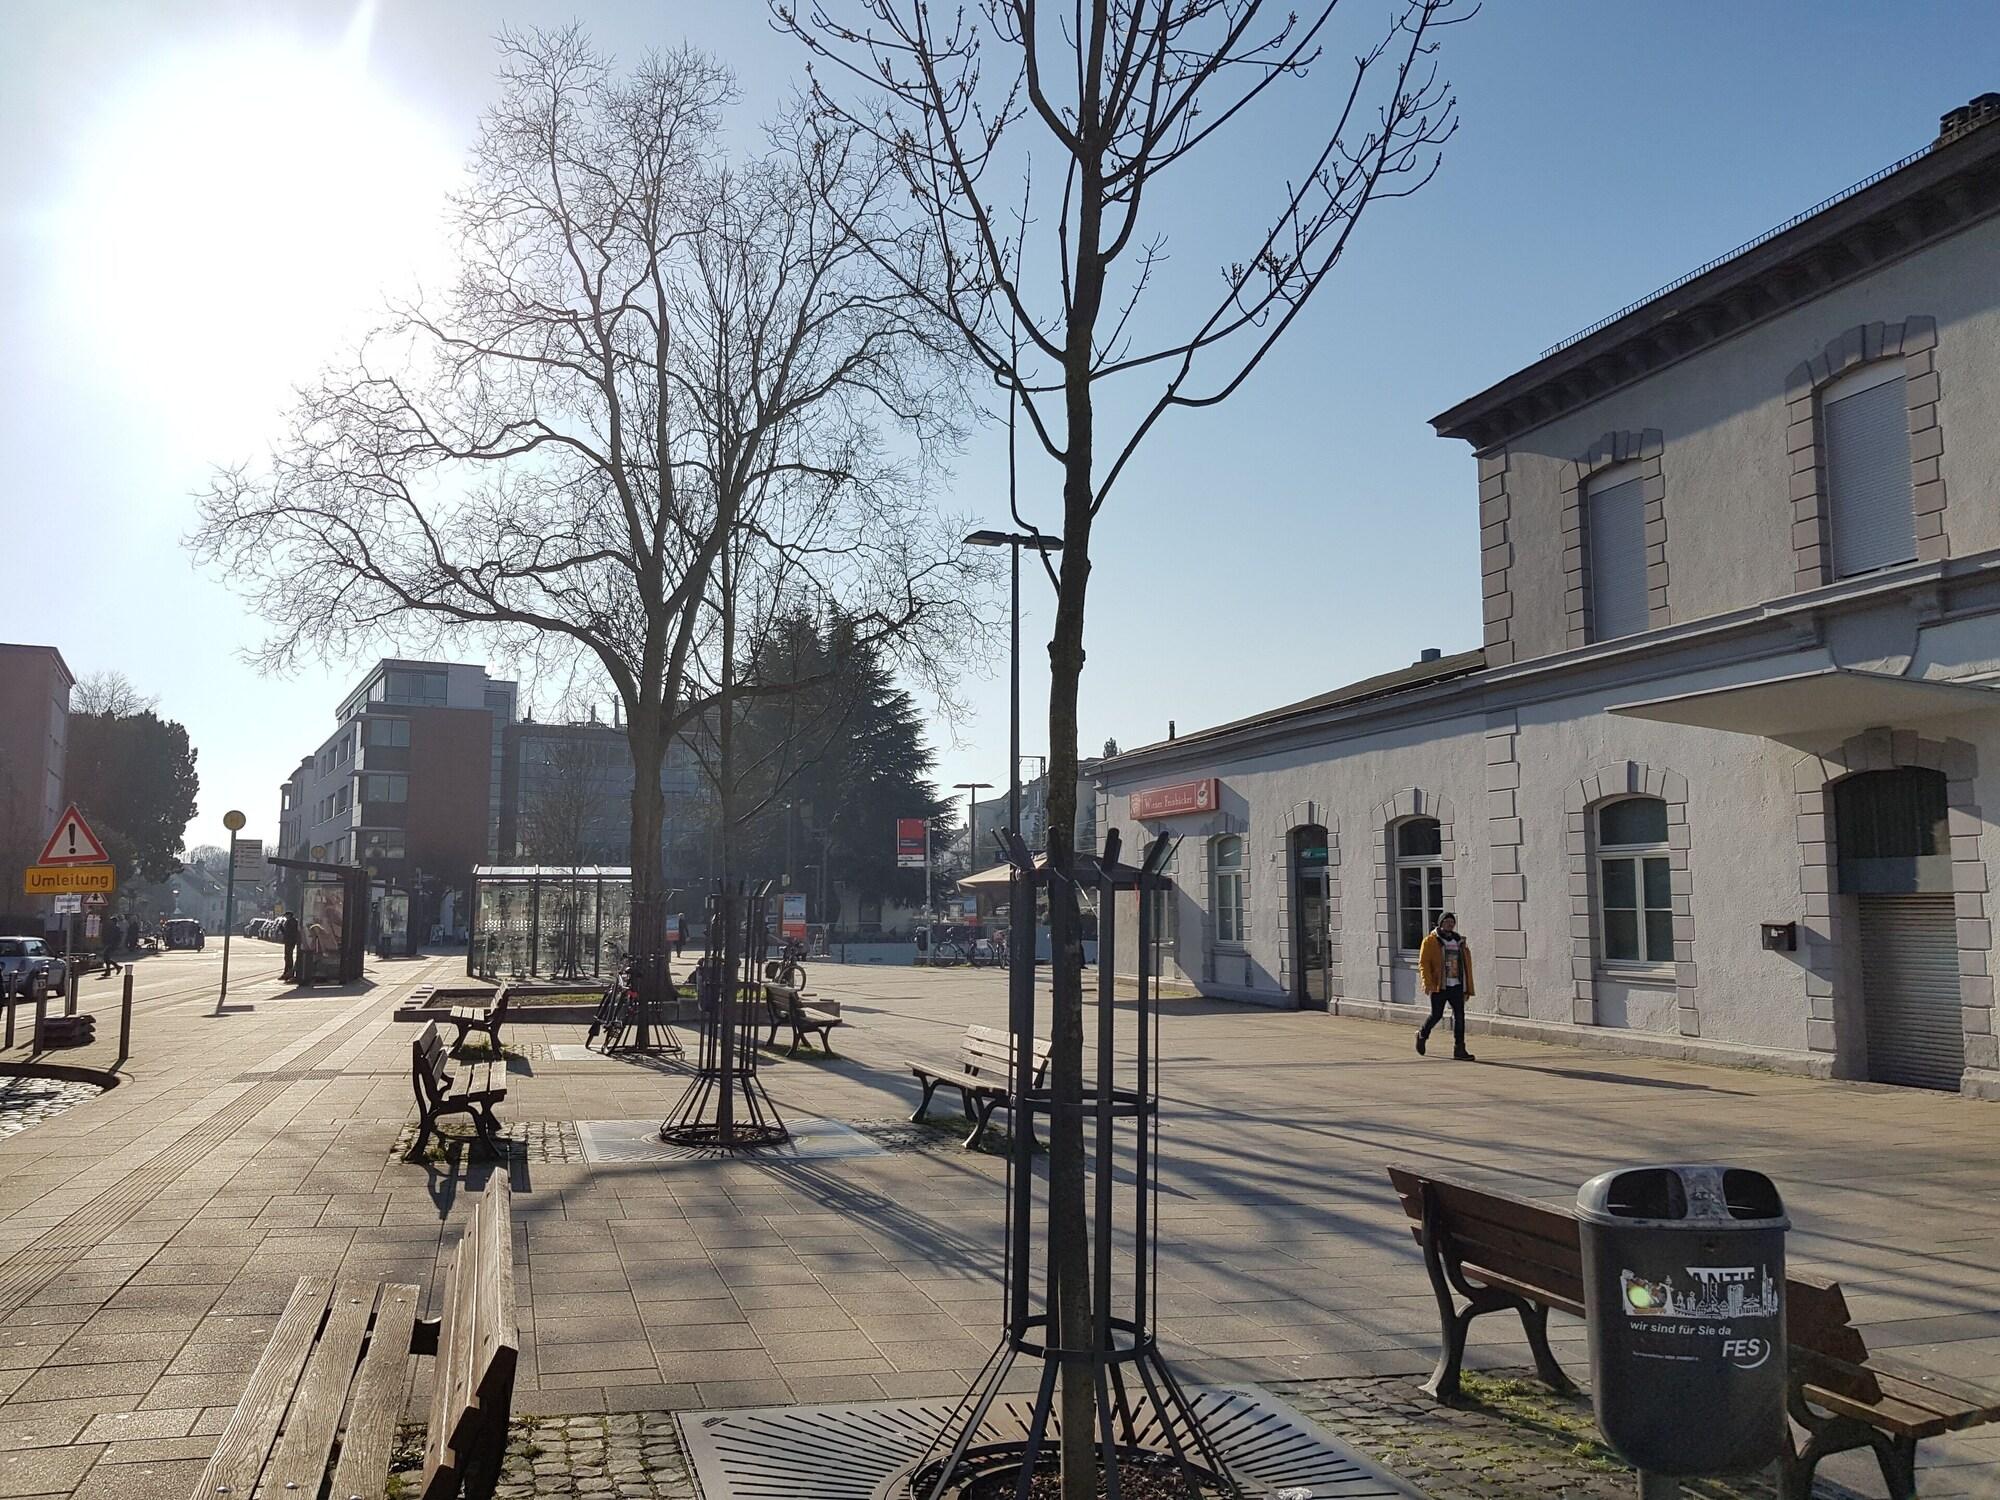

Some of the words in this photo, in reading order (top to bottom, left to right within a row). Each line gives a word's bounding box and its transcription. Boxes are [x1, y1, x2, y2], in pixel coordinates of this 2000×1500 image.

[31, 874, 109, 888] Umleitung
[1630, 1321, 1648, 1331] wir
[1651, 1324, 1675, 1334] sind
[1678, 1325, 1695, 1335] für
[1698, 1325, 1716, 1335] Sie
[1718, 1326, 1731, 1336] da
[1722, 1338, 1760, 1358] FES
